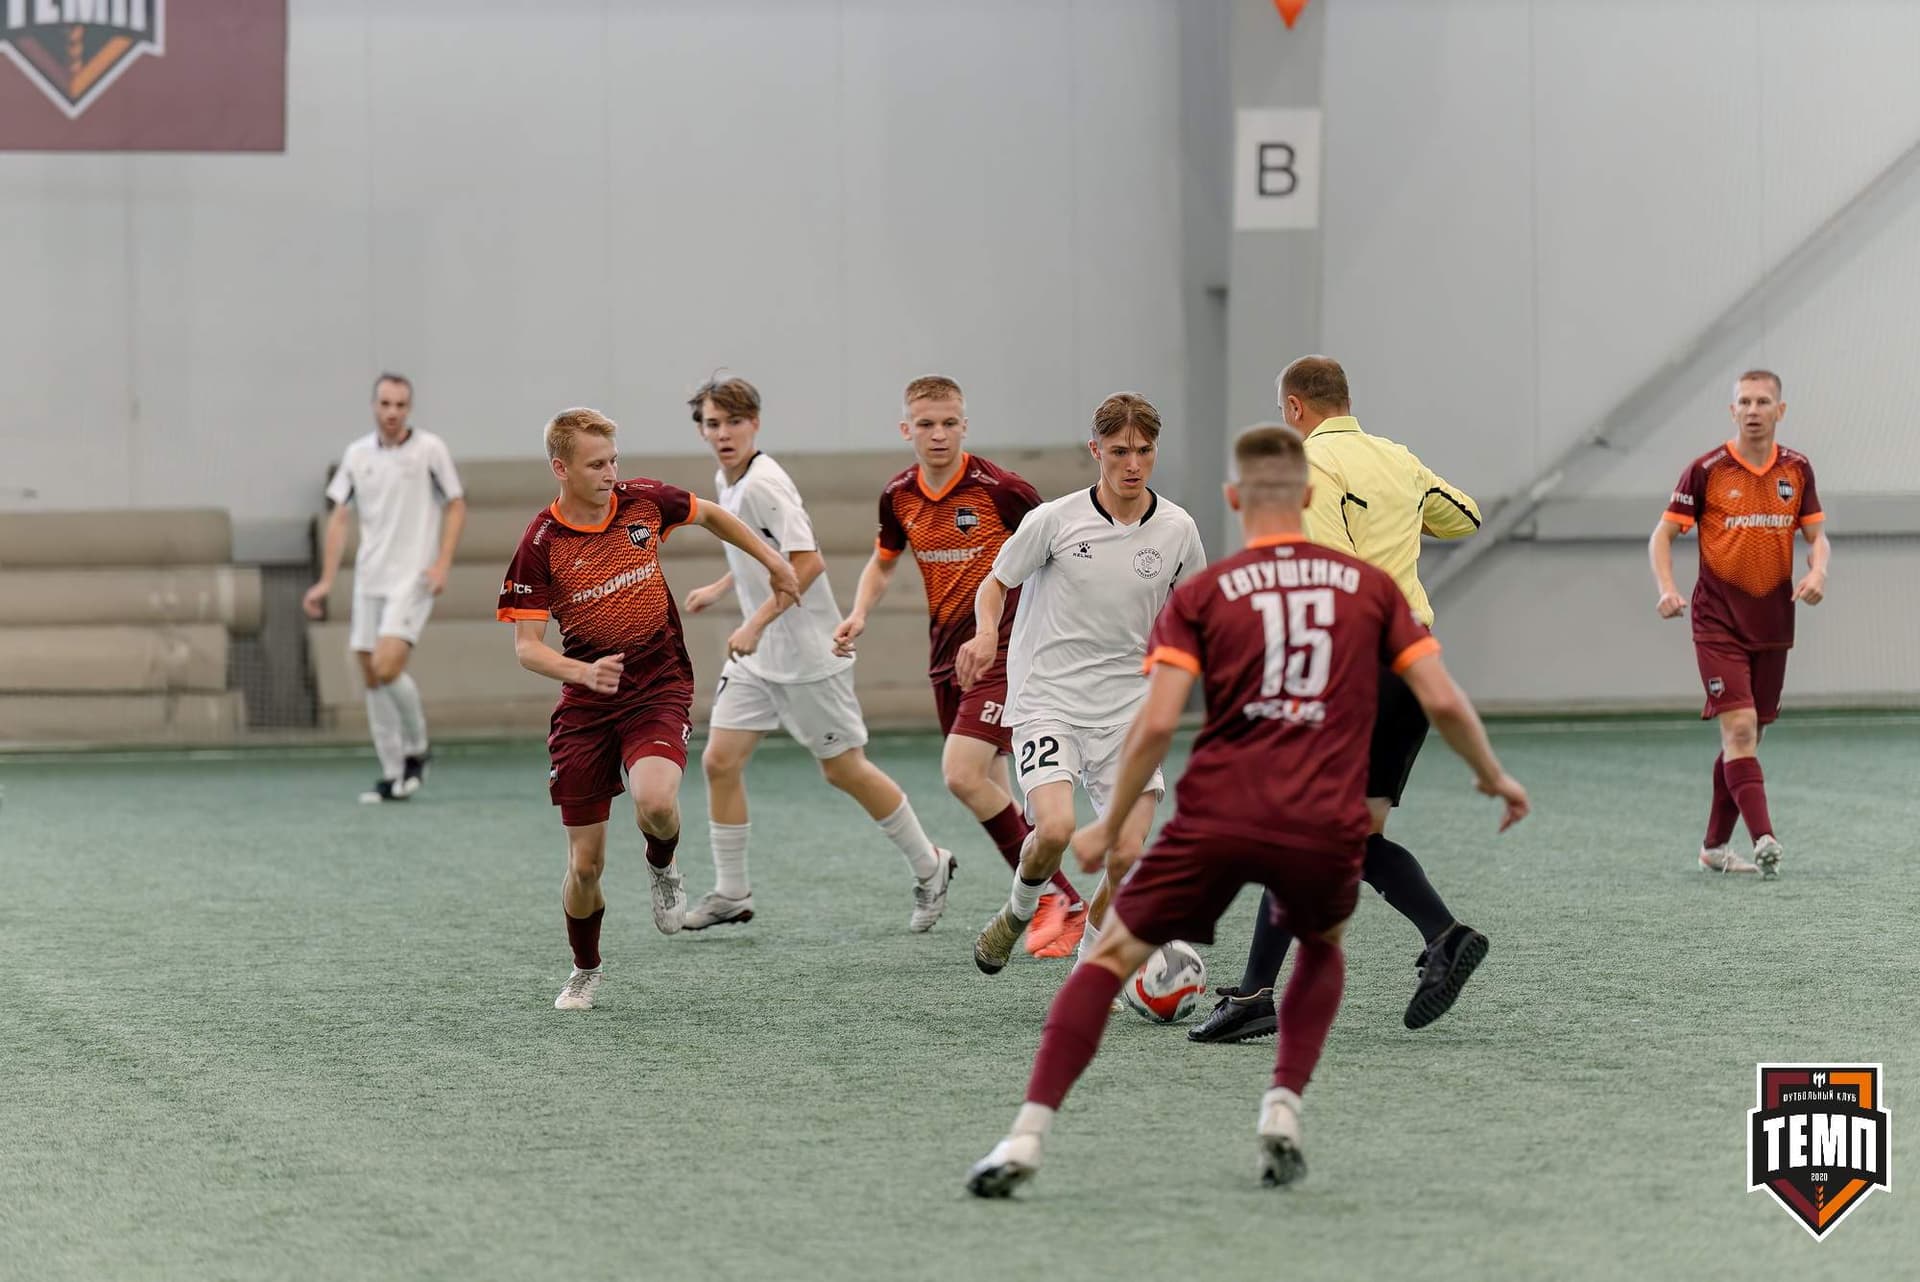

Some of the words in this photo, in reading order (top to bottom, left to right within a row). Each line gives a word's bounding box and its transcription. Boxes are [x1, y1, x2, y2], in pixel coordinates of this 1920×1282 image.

[1250, 587, 1335, 698] 15
[980, 700, 1004, 725] 27
[1020, 735, 1059, 777] 22
